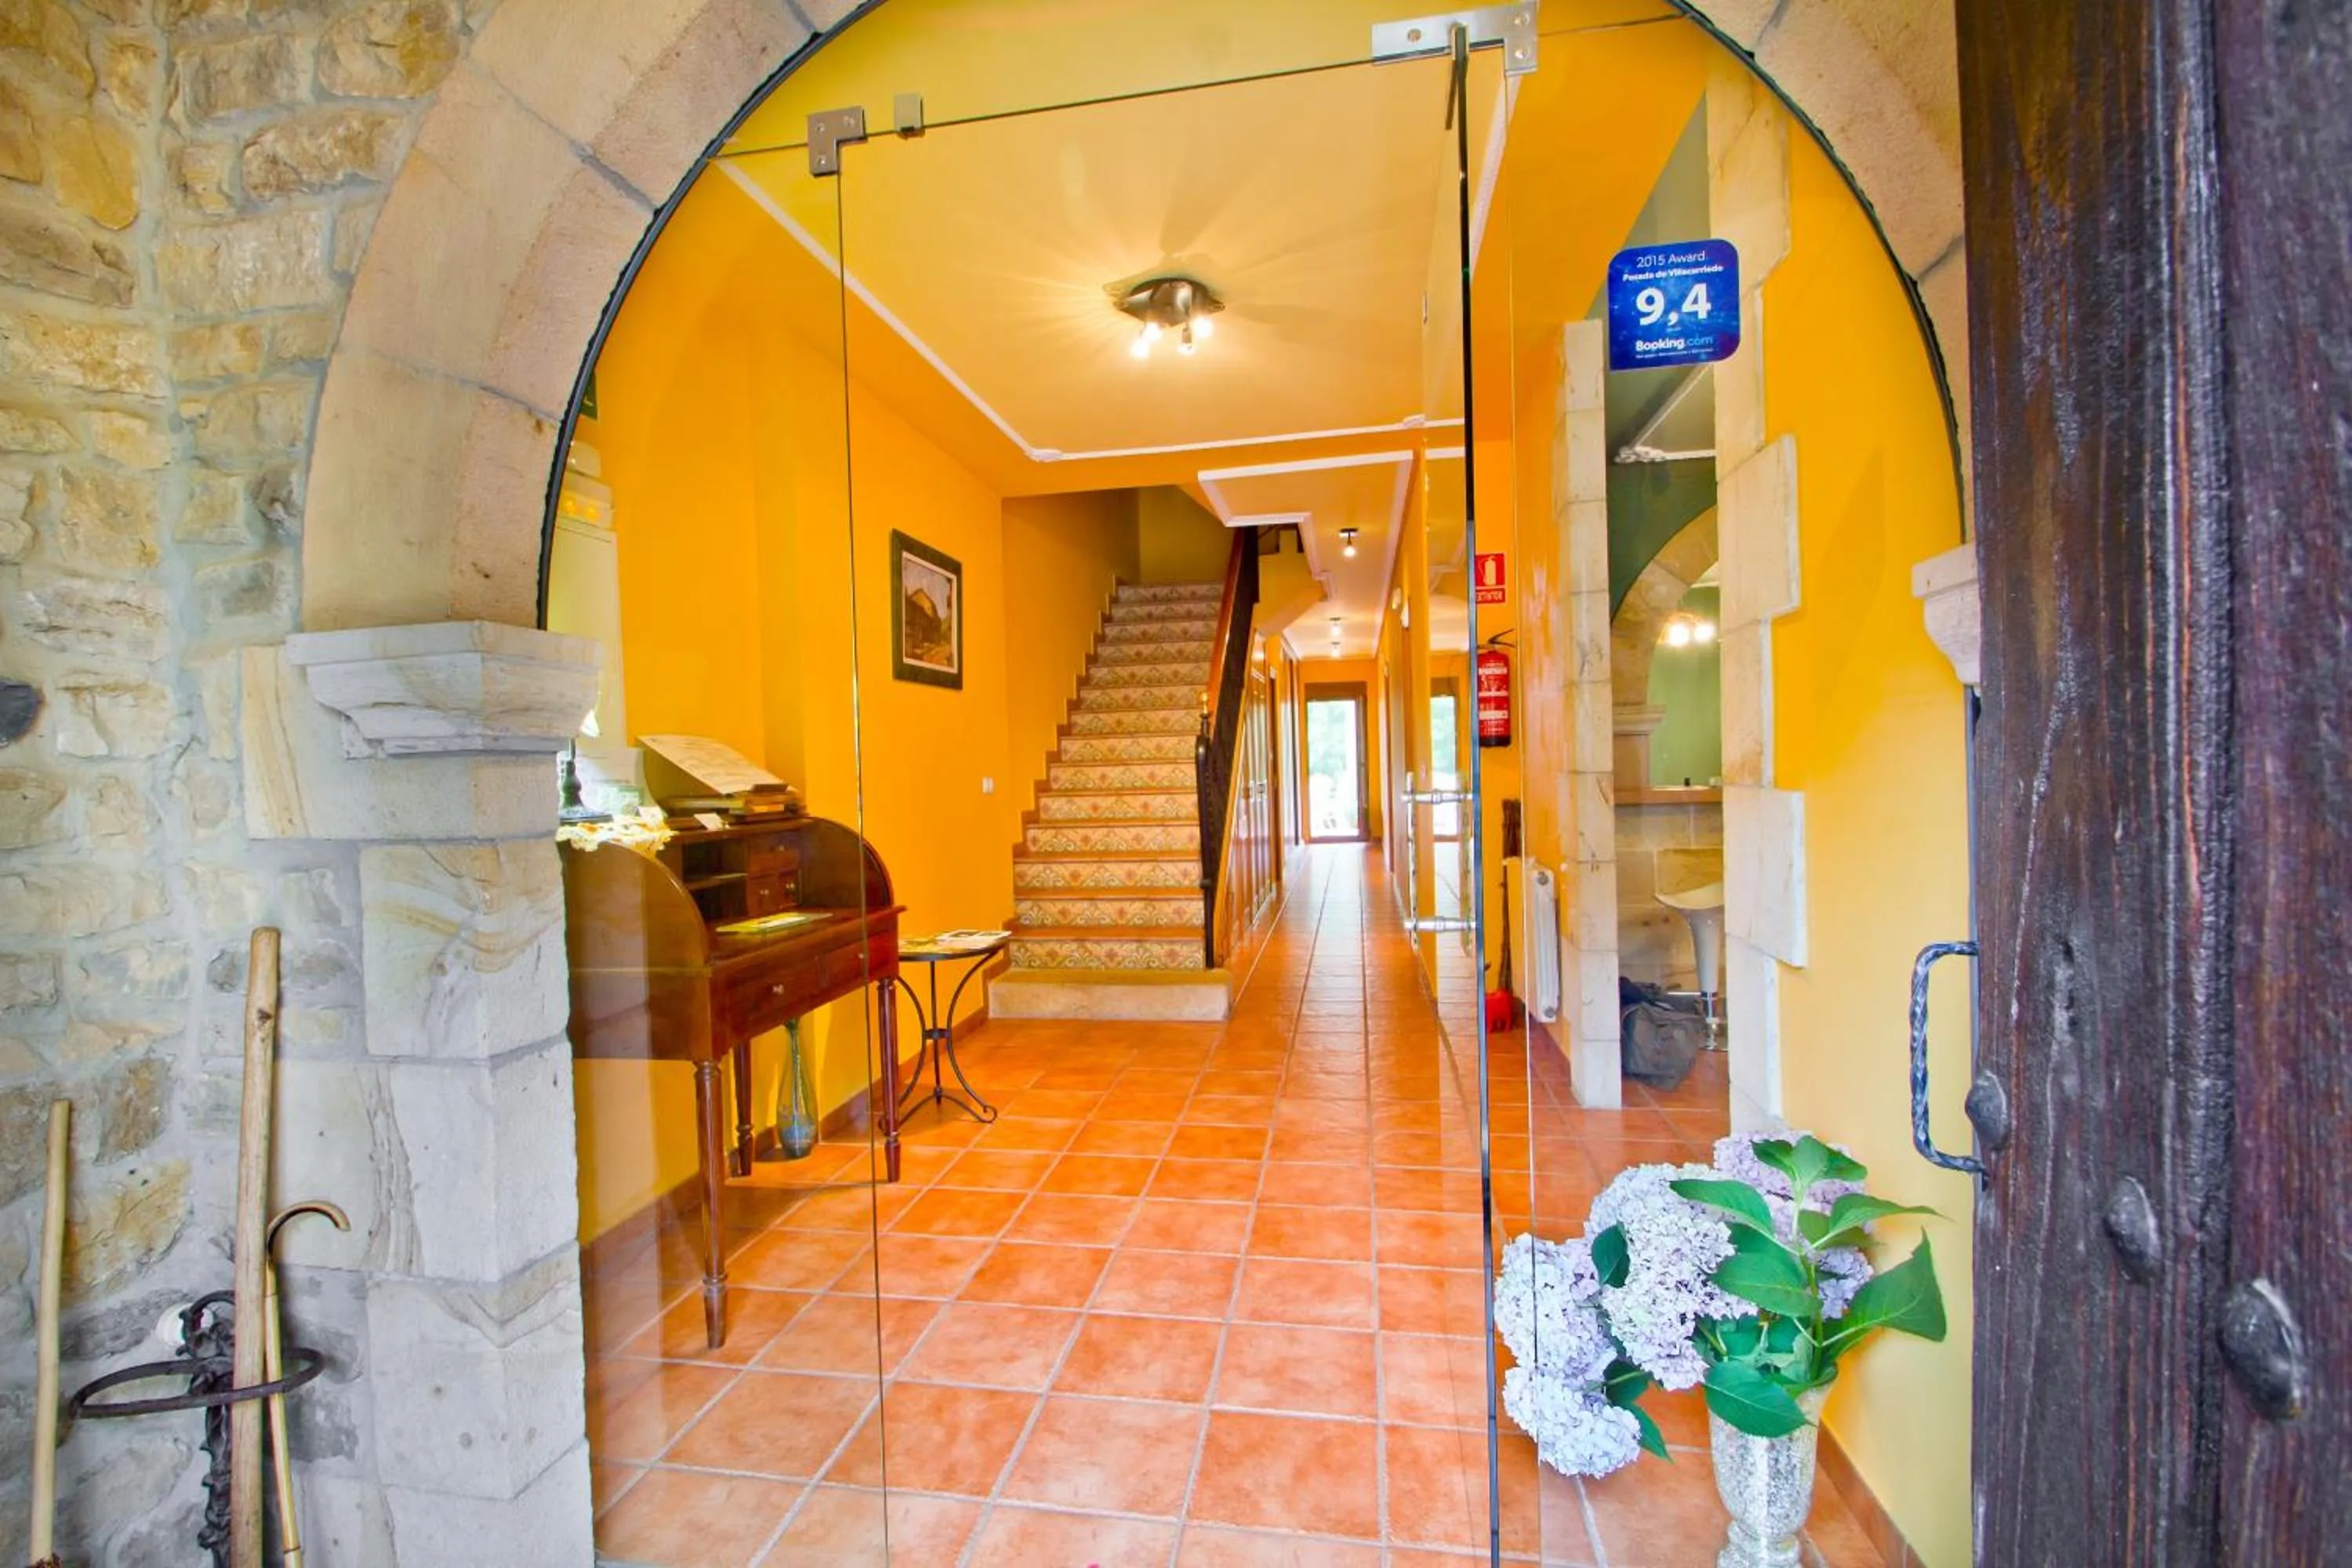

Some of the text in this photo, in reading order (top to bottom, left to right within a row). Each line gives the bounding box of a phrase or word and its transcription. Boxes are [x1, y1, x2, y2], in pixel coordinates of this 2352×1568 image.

[1637, 250, 1705, 268] 2015 Award
[1636, 283, 1711, 326] 9,4
